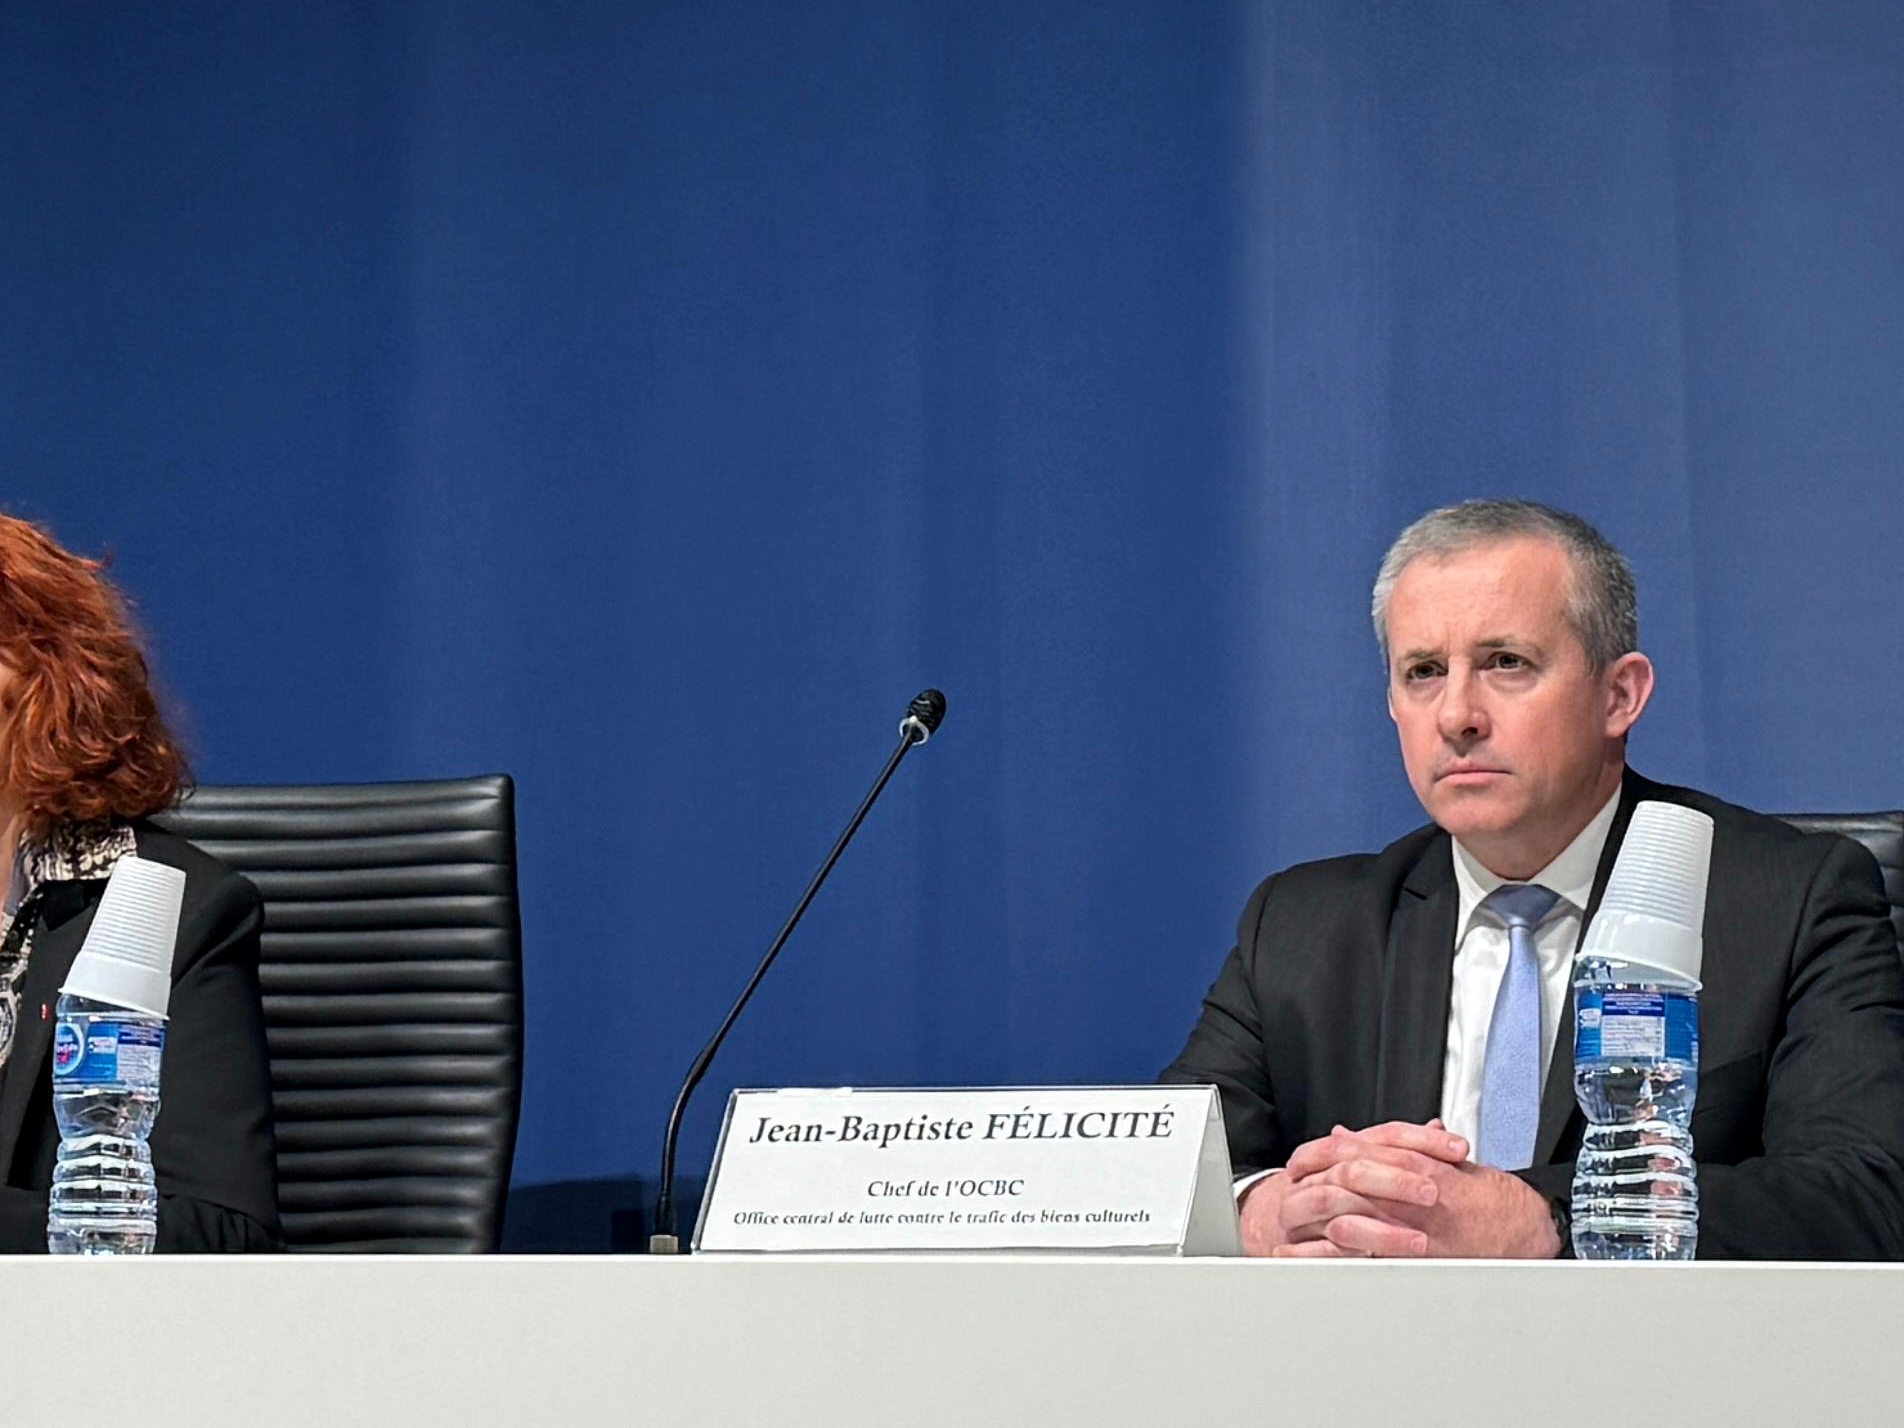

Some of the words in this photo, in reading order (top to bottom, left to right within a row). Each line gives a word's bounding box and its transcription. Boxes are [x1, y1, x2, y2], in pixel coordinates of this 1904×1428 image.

[749, 1113, 974, 1149] Jean-Baptiste
[981, 1105, 1176, 1141] FÉLICITÉ
[868, 1179, 916, 1197] Chef
[917, 1180, 939, 1197] de
[733, 1211, 778, 1225] Office
[782, 1211, 834, 1224] central
[838, 1211, 855, 1224] de
[859, 1211, 893, 1224] lutte
[898, 1212, 944, 1224] contre
[949, 1210, 962, 1223] le
[967, 1210, 1007, 1223] trafic
[1011, 1210, 1035, 1223] des
[1040, 1209, 1080, 1223] biens
[1085, 1209, 1151, 1223] culturels
